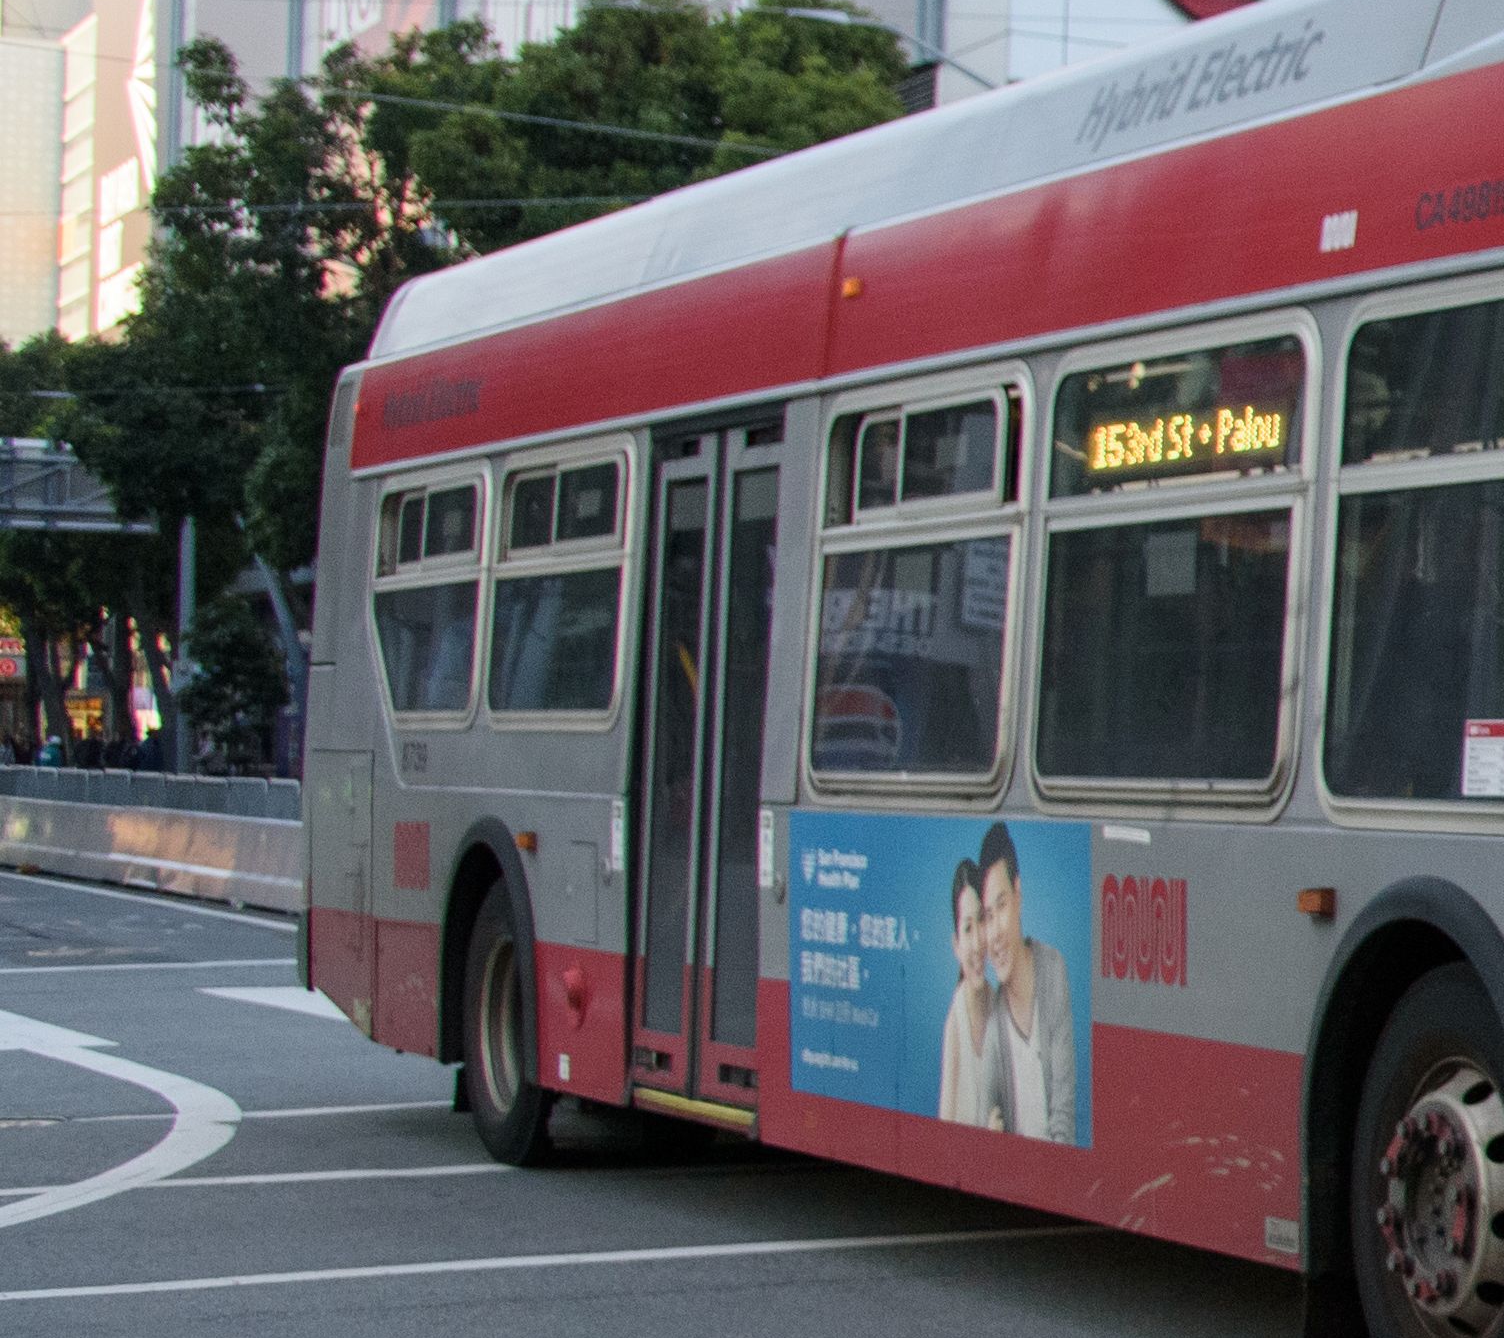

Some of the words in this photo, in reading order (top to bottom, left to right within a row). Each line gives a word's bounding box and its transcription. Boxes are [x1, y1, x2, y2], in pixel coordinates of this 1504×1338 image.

[1073, 54, 1202, 153] Hybrid
[1185, 17, 1326, 112] Electric
[1166, 413, 1195, 461] St
[1216, 405, 1282, 456] Palou
